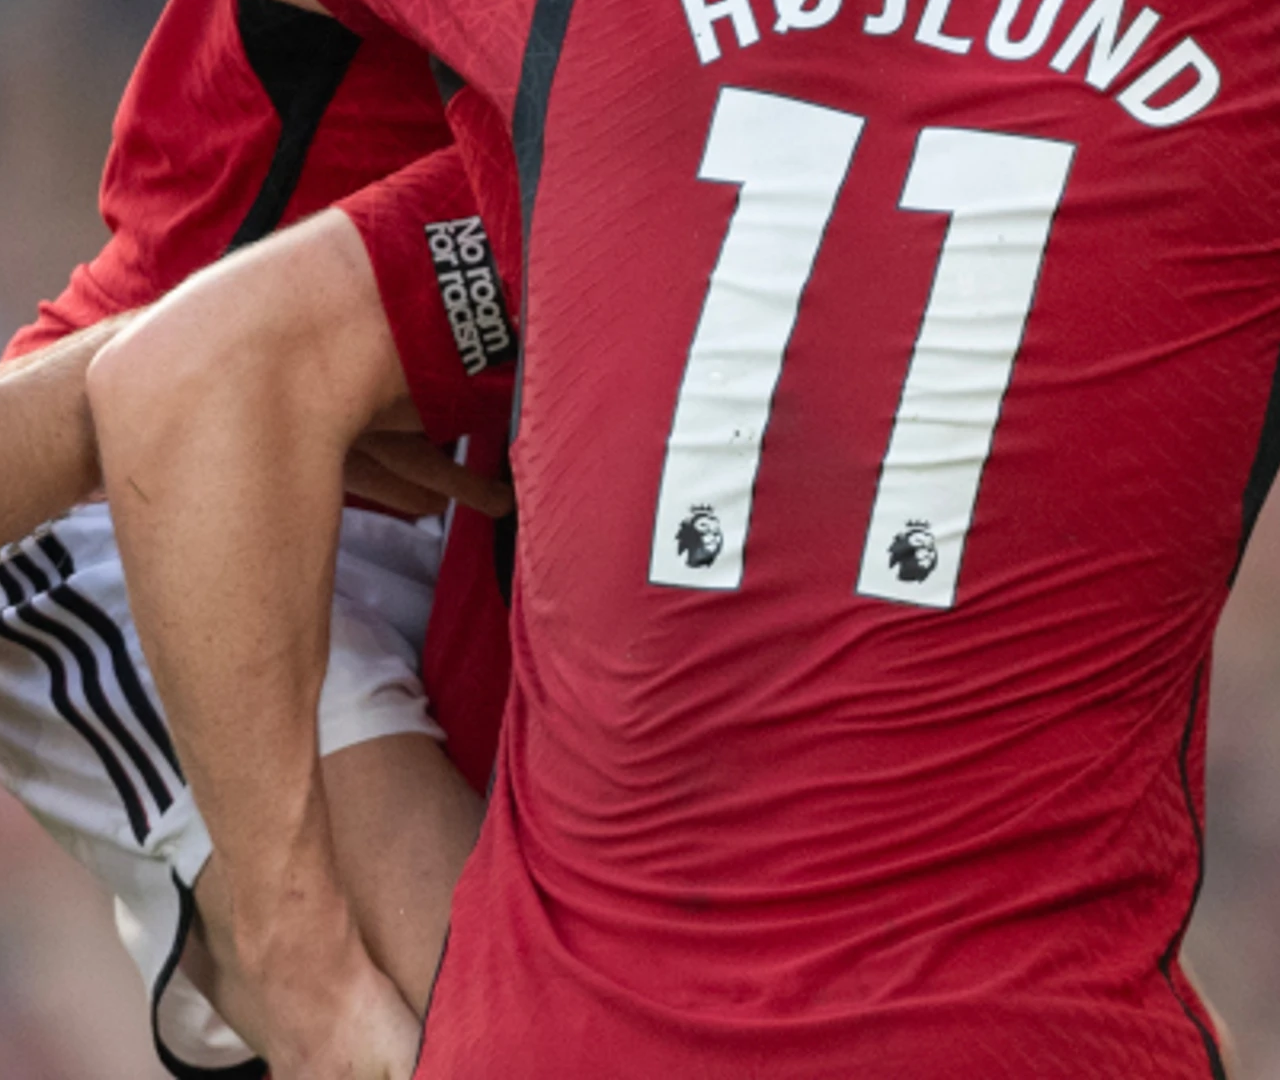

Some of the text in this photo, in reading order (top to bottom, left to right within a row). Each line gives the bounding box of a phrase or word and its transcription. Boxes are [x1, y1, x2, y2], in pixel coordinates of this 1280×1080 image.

[425, 222, 488, 376] for racism
[451, 215, 510, 353] No room
[648, 85, 1078, 609] 11
